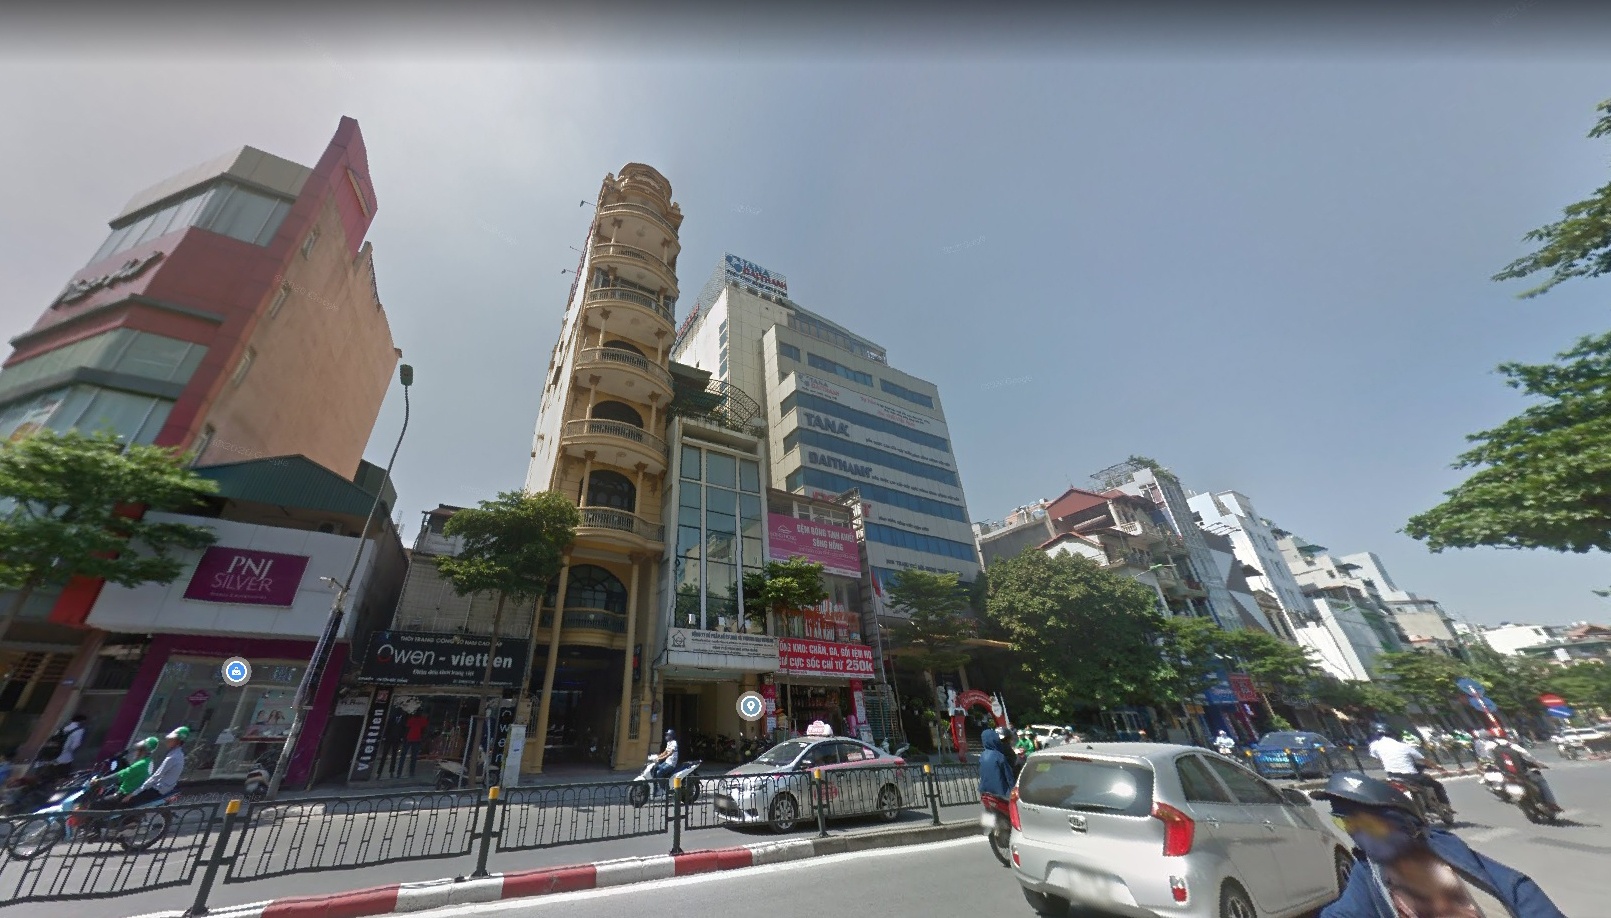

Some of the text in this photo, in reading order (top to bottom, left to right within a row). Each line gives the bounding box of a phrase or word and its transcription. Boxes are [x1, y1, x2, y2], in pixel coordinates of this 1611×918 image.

[803, 412, 850, 437] TANA
[226, 555, 274, 581] PNJ
[210, 572, 274, 592] SILVER
[377, 643, 436, 666] Owen
[451, 651, 513, 669] vietten
[806, 655, 821, 668] SỐC
